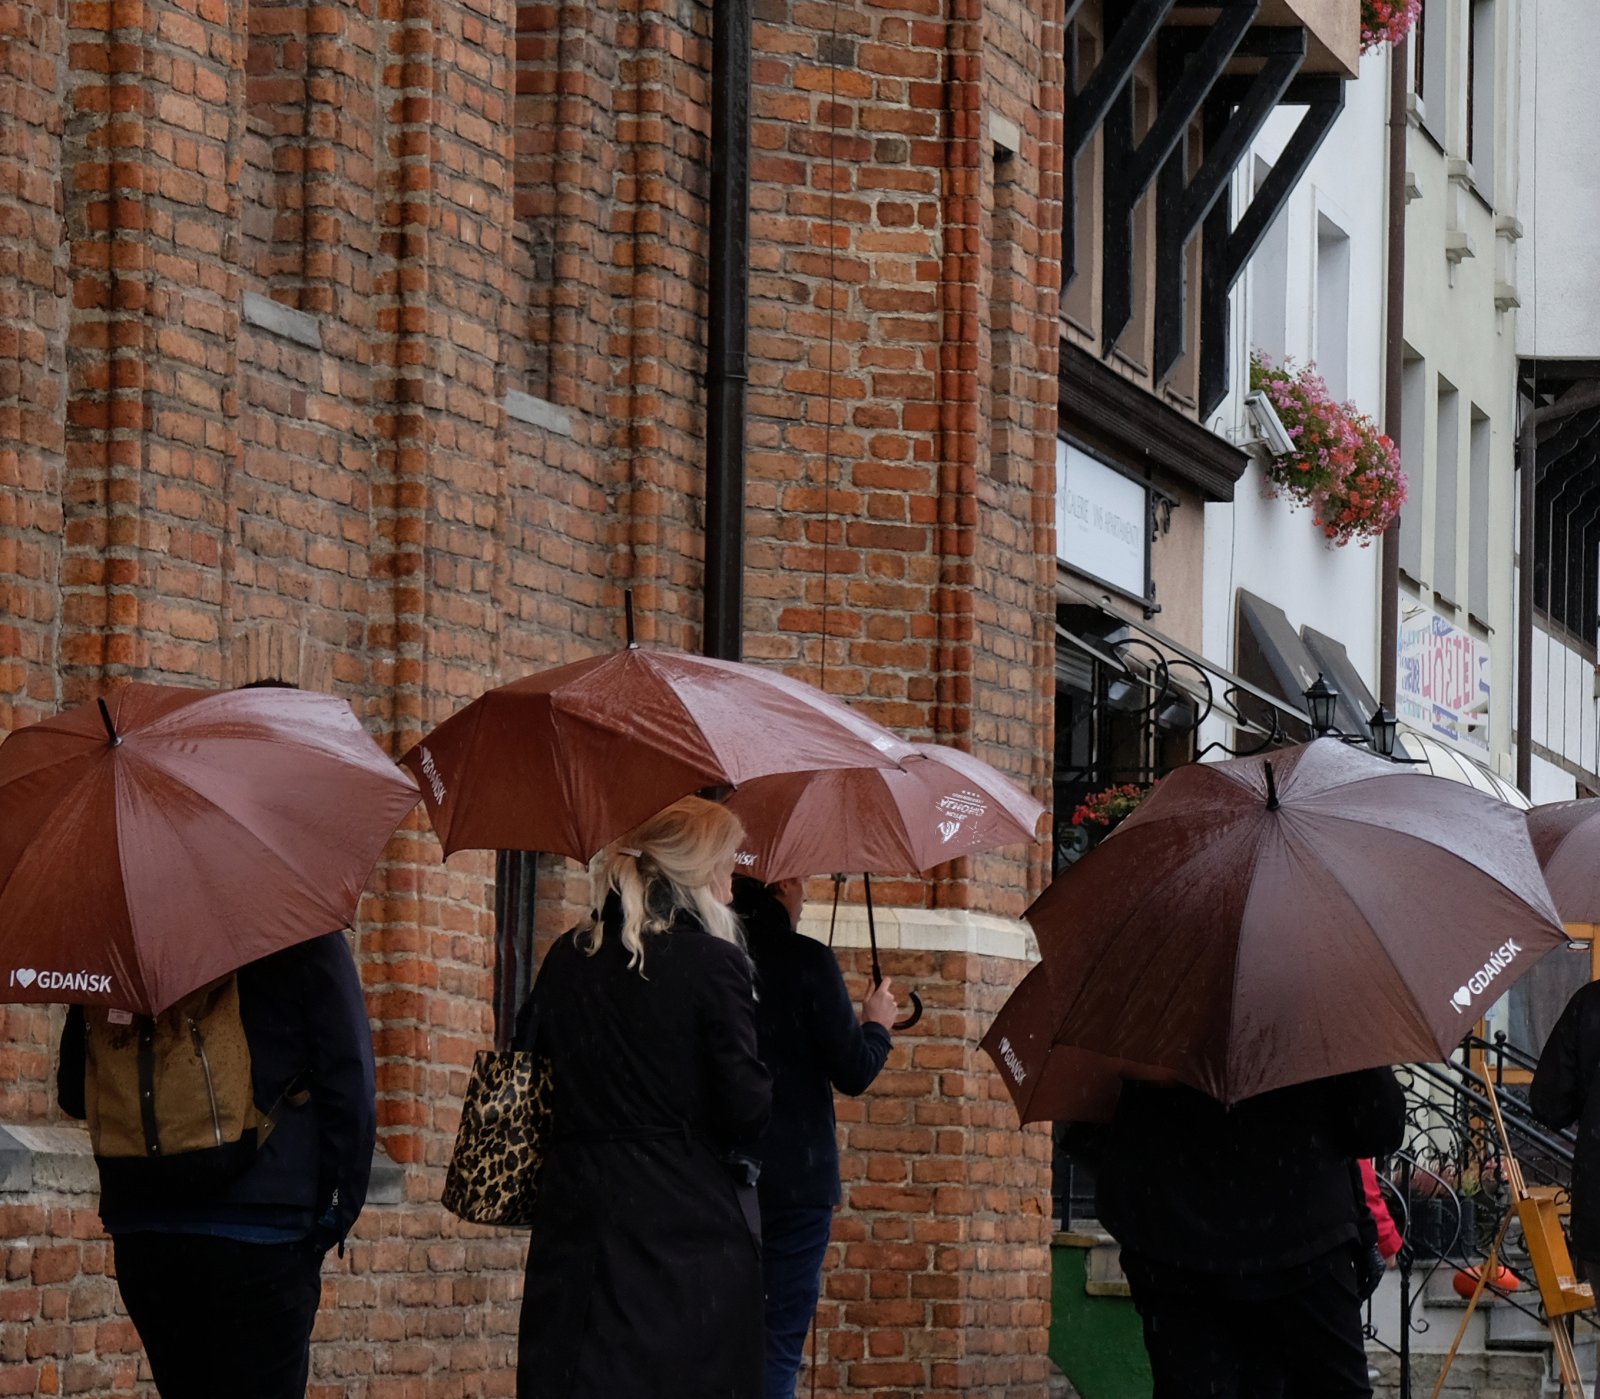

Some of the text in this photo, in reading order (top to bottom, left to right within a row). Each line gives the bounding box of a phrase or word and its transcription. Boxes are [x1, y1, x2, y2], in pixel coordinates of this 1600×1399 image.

[9, 969, 113, 994] I GDAŃSK
[1449, 937, 1522, 1014] I GDAŃSK
